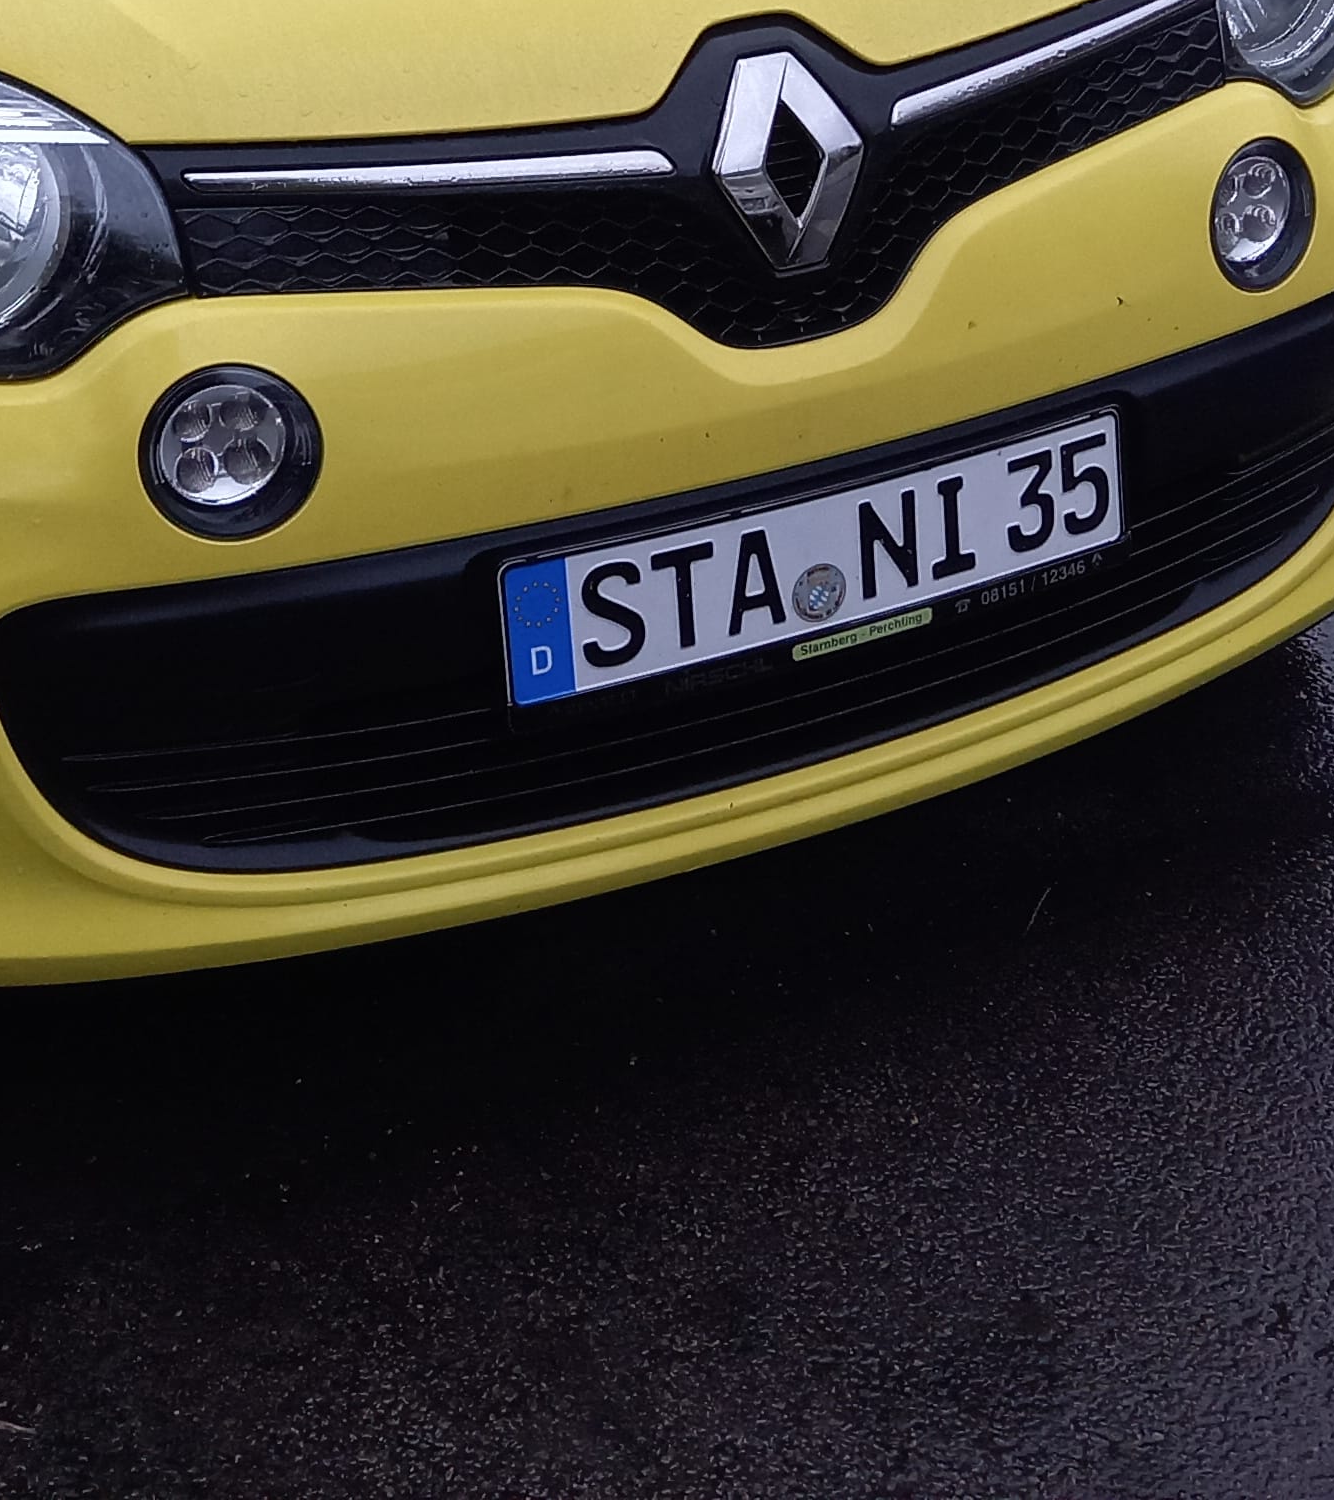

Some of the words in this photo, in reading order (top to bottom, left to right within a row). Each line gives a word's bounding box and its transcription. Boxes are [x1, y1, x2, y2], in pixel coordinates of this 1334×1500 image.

[581, 530, 786, 668] STA
[858, 476, 976, 600] NI
[1007, 433, 1109, 553] 35
[981, 579, 1025, 605] 08151
[1041, 560, 1086, 586] 12346
[530, 645, 553, 676] D
